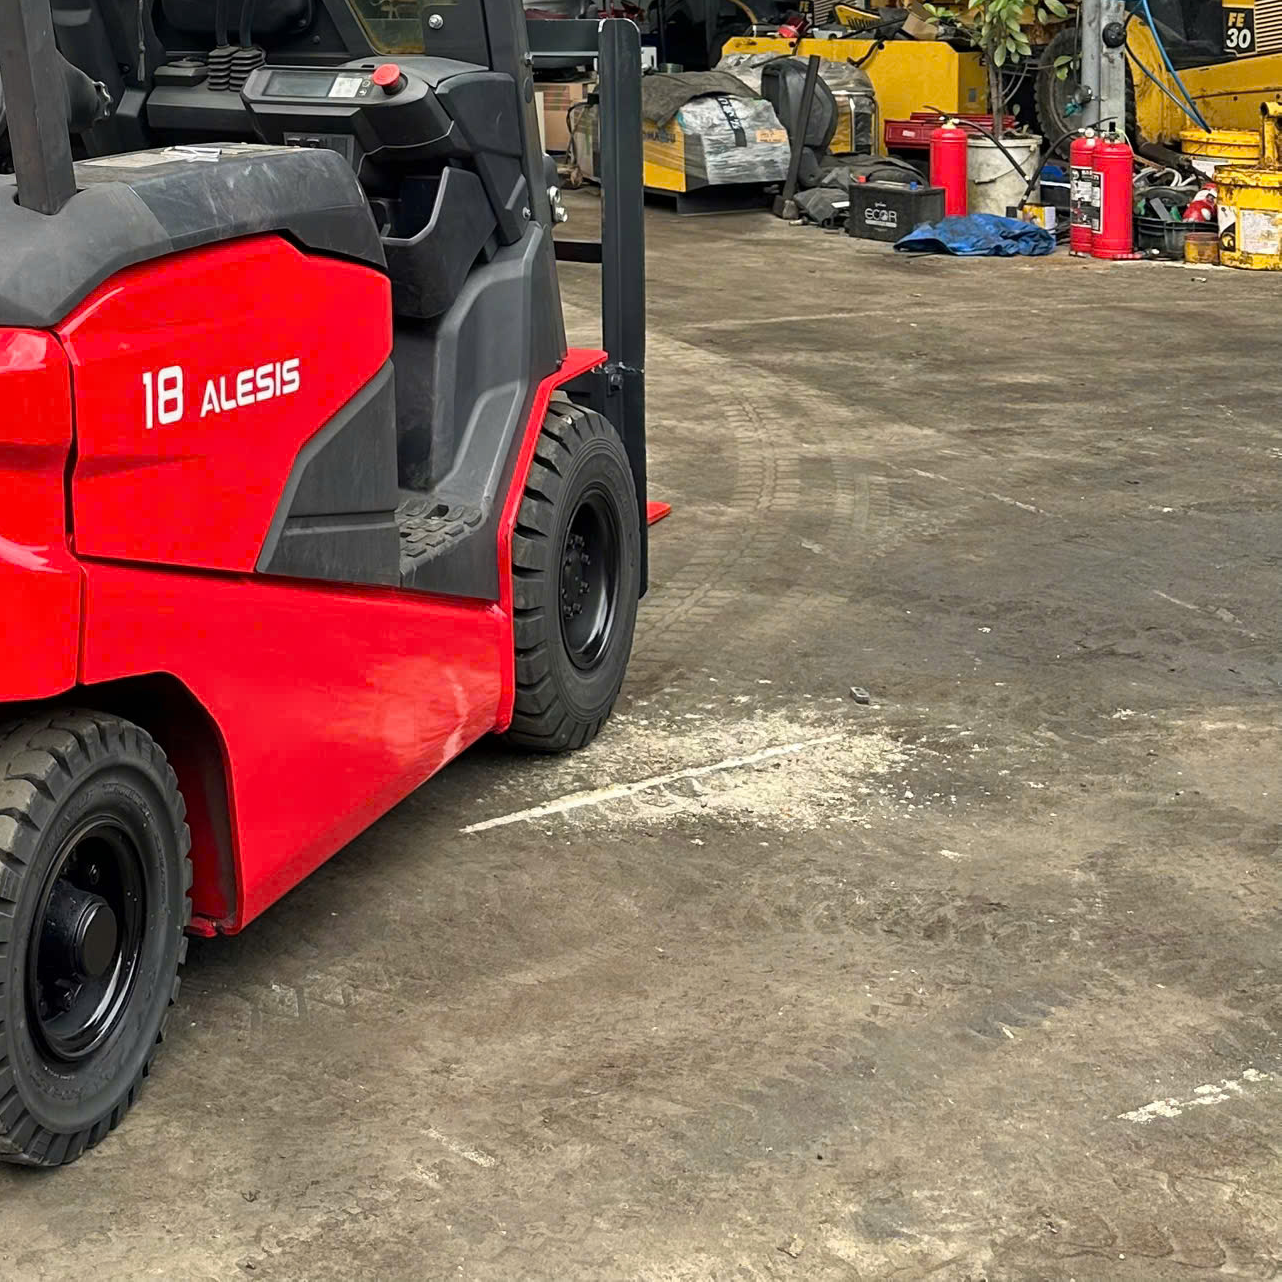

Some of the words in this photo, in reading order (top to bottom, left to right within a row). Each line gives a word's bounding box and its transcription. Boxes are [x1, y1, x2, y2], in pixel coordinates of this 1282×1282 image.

[1228, 12, 1245, 27] FE
[1226, 28, 1251, 49] 30
[143, 365, 184, 429] 18
[200, 358, 300, 418] ALESIS
